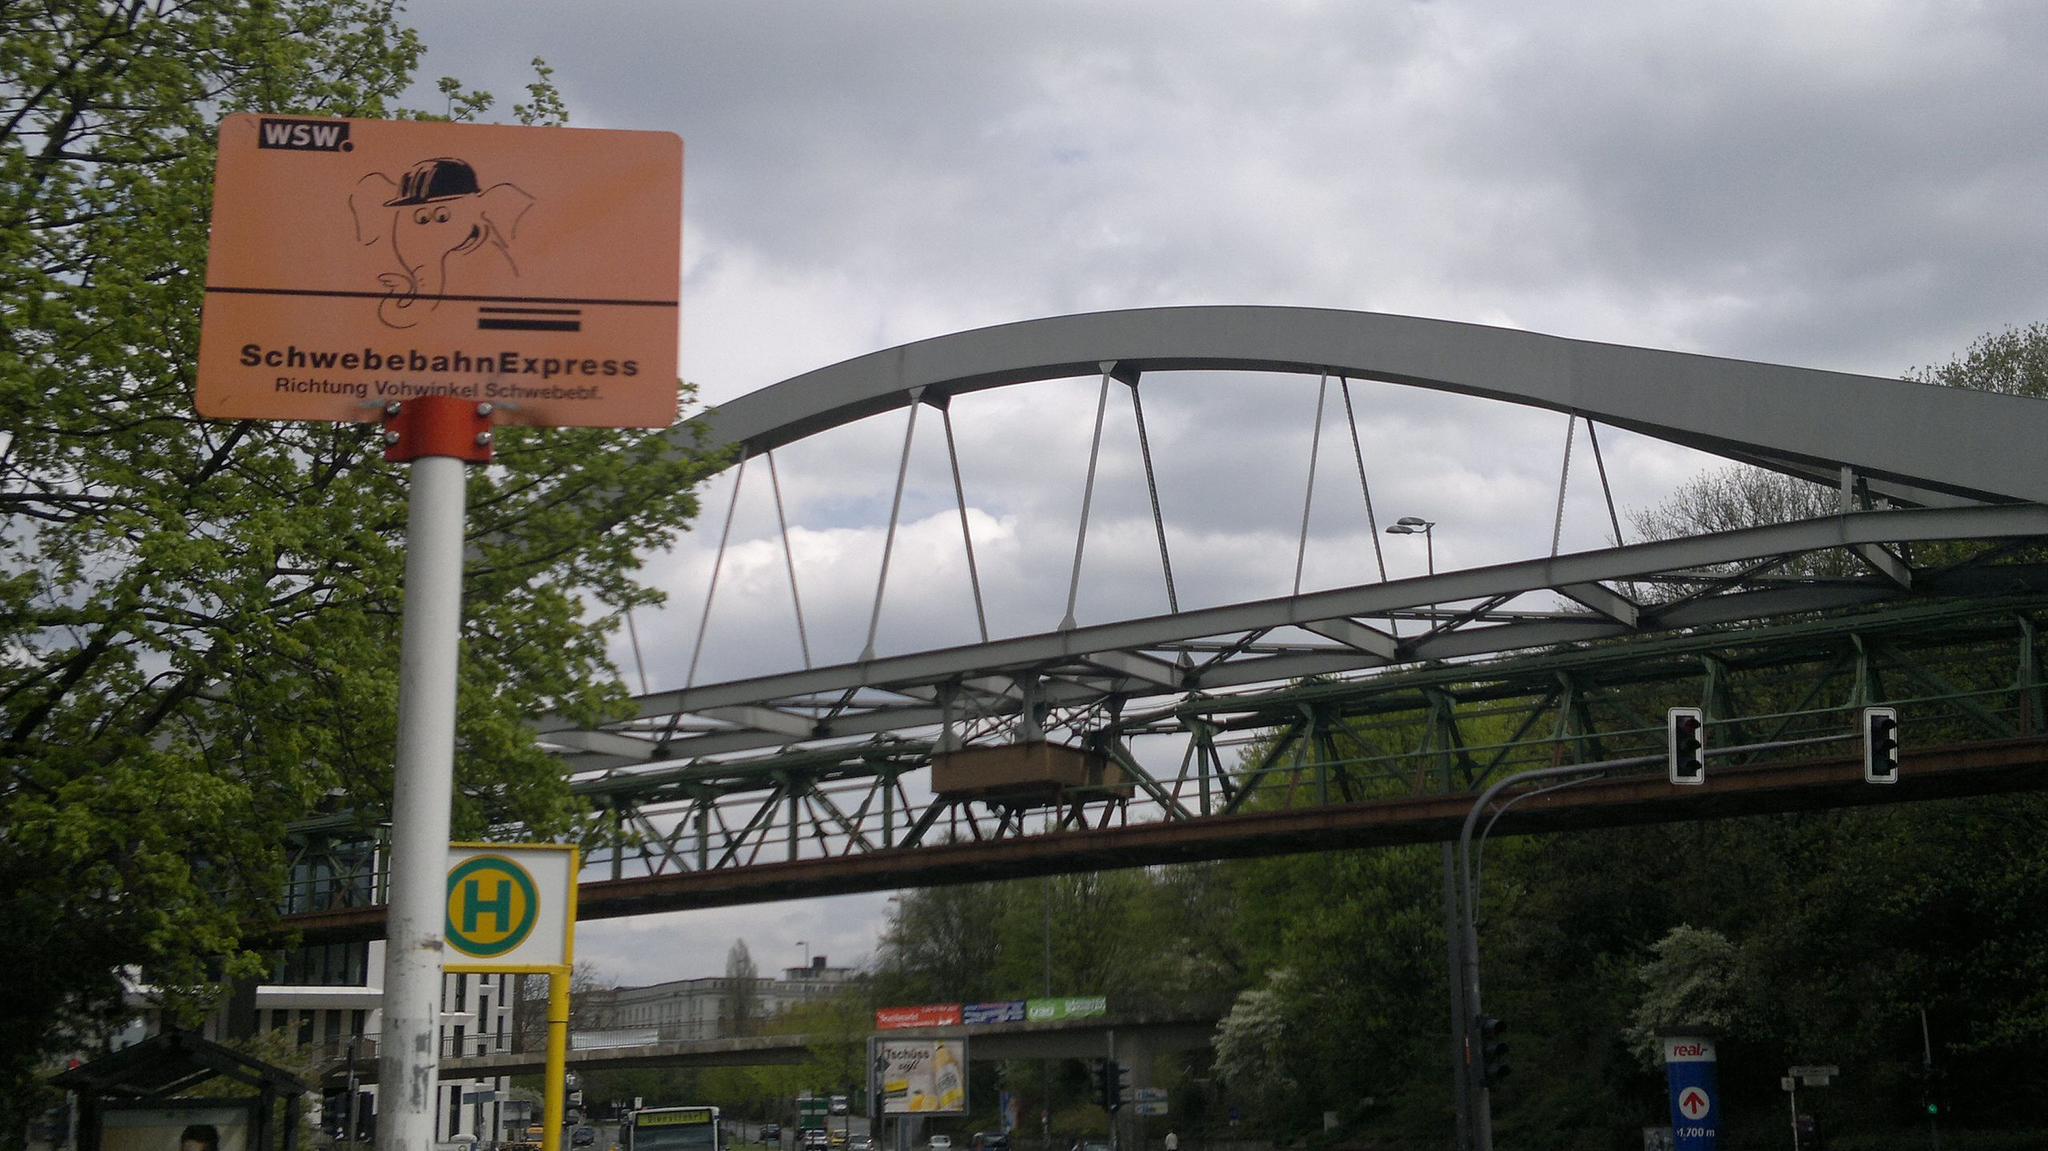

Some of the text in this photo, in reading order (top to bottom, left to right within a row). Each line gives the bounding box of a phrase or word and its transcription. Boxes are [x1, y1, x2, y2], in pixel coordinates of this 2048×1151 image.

[240, 344, 639, 379] SchwebebahnExpress
[275, 377, 368, 398] Richtung
[375, 380, 478, 398] Vohwinkel
[462, 879, 511, 933] H
[1706, 1128, 1715, 1138] m
